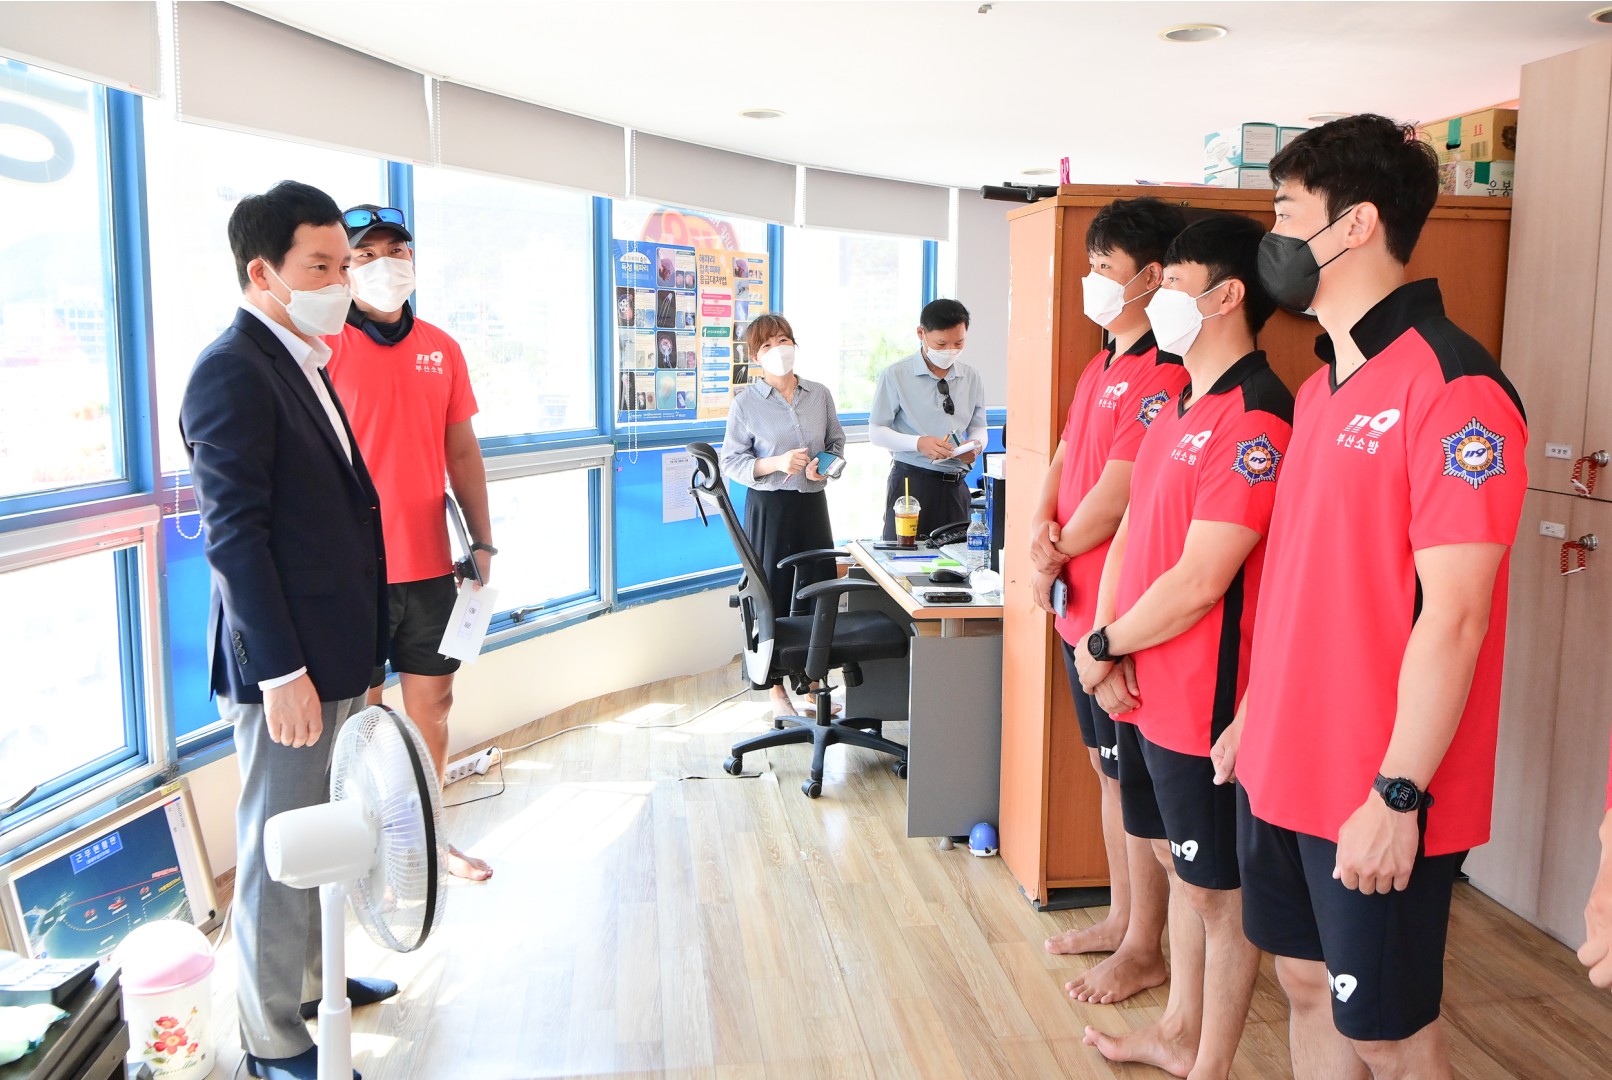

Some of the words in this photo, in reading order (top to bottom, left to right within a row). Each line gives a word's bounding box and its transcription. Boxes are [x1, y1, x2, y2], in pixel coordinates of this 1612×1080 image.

[699, 275, 728, 286] 응급대처법
[415, 351, 444, 366] 119
[415, 365, 444, 375] 부산소방
[1336, 433, 1380, 455] 부산소방
[1170, 449, 1197, 466] 부산소방
[1464, 447, 1487, 459] 119
